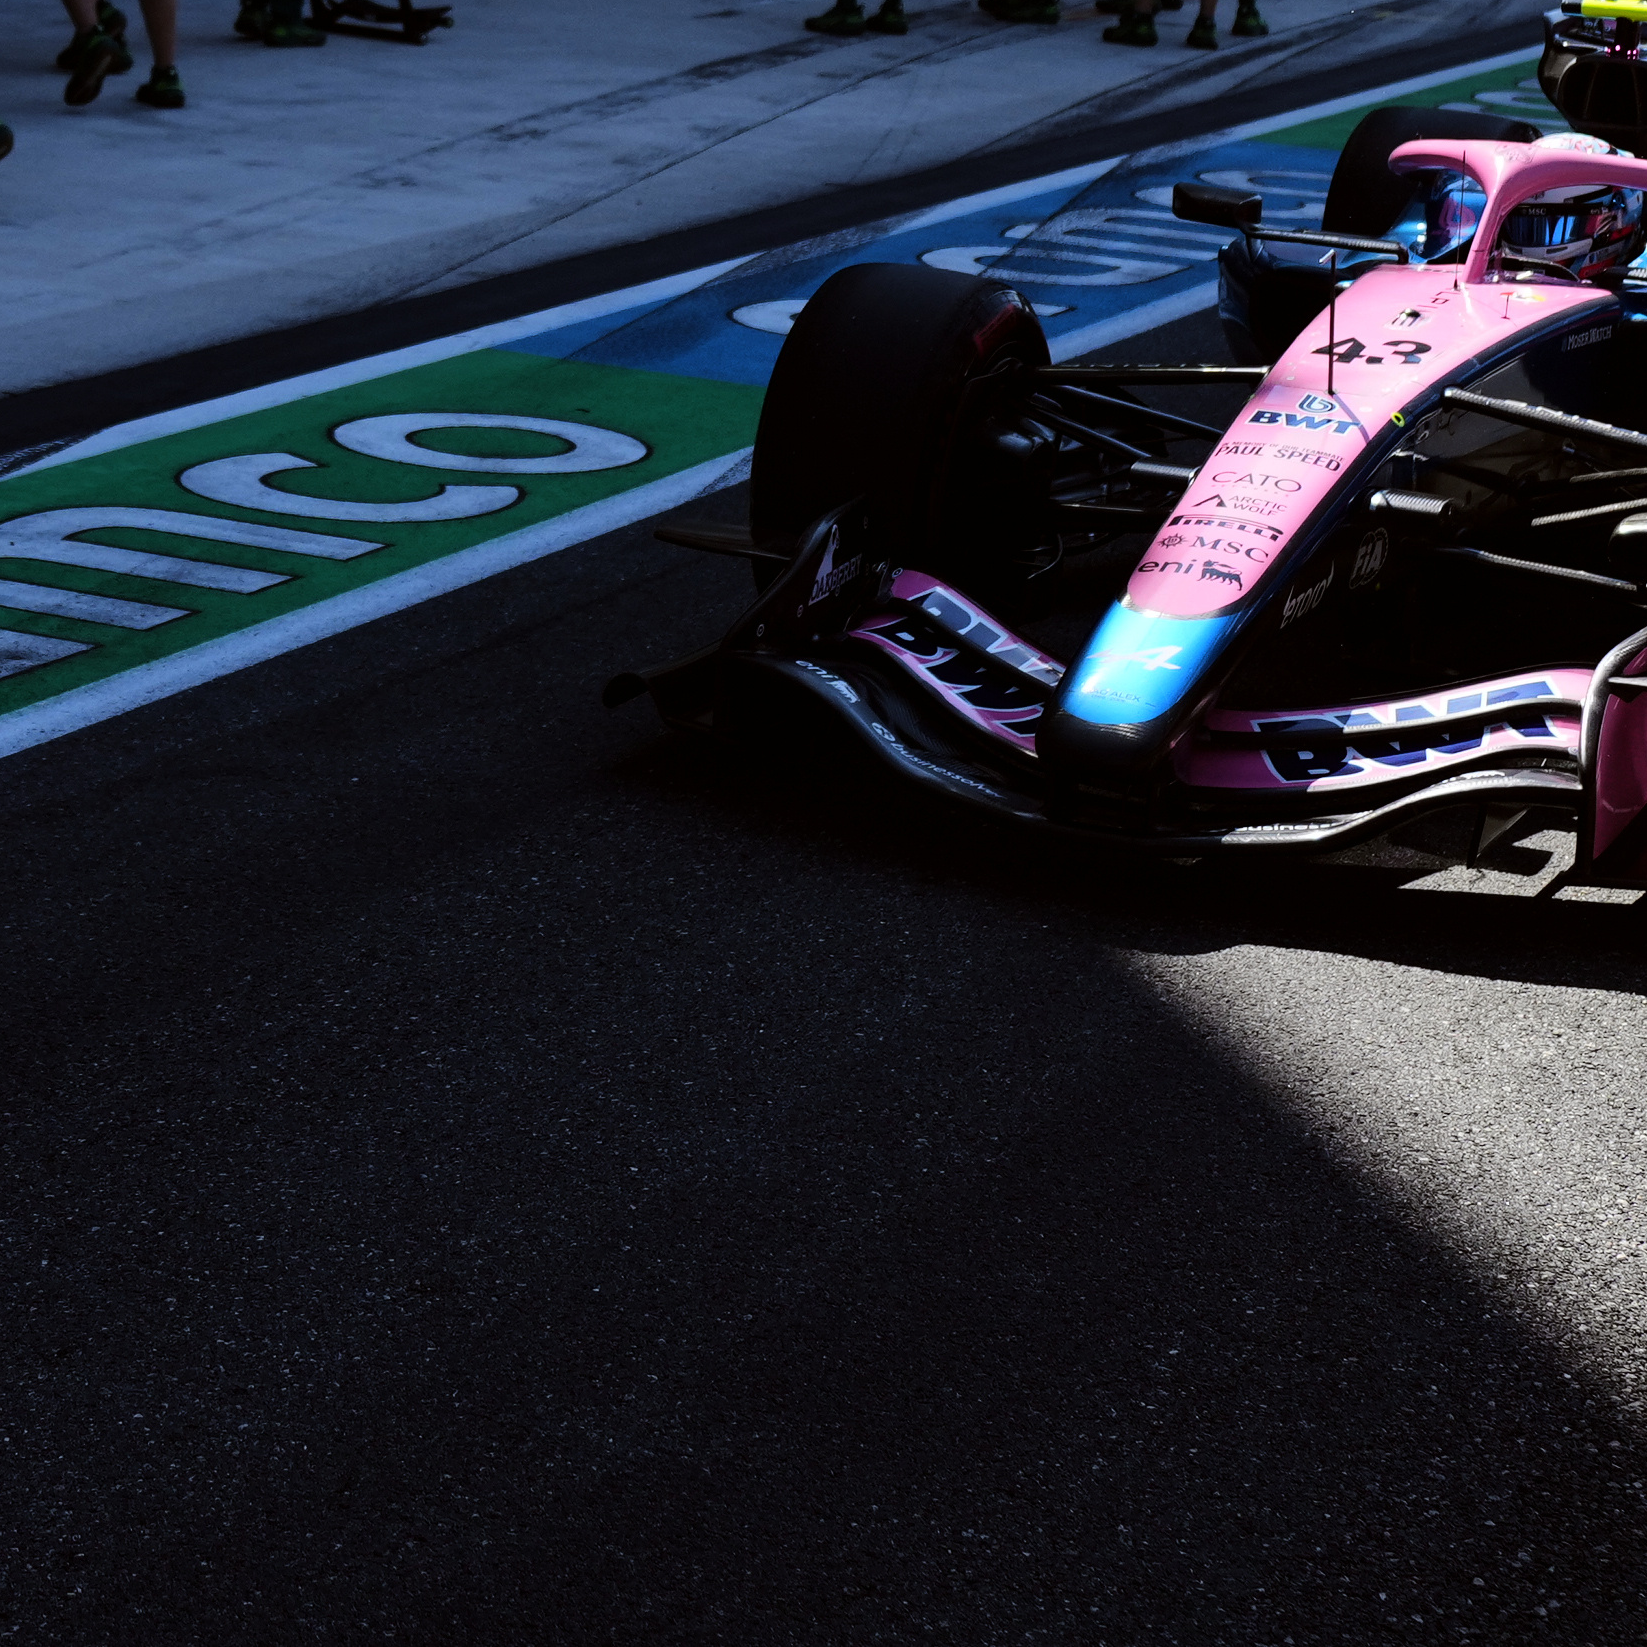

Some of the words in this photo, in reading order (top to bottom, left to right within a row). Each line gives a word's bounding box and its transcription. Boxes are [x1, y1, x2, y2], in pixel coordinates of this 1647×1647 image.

[1528, 207, 1547, 215] MSC
[1311, 337, 1432, 365] 43
[1247, 409, 1362, 435] BWT
[1214, 445, 1264, 457] PAUL
[1273, 448, 1342, 472] SPEED
[1282, 444, 1299, 452] OUR
[1211, 471, 1302, 493] CATO
[1229, 495, 1288, 513] ARCTIC
[1233, 503, 1280, 517] WOLF
[1167, 513, 1284, 542] PIRELLI
[1190, 535, 1269, 564] MSC
[1138, 558, 1197, 574] eni
[795, 659, 838, 681] eni
[1111, 691, 1141, 702] ALEX
[891, 742, 1008, 800] businessolver
